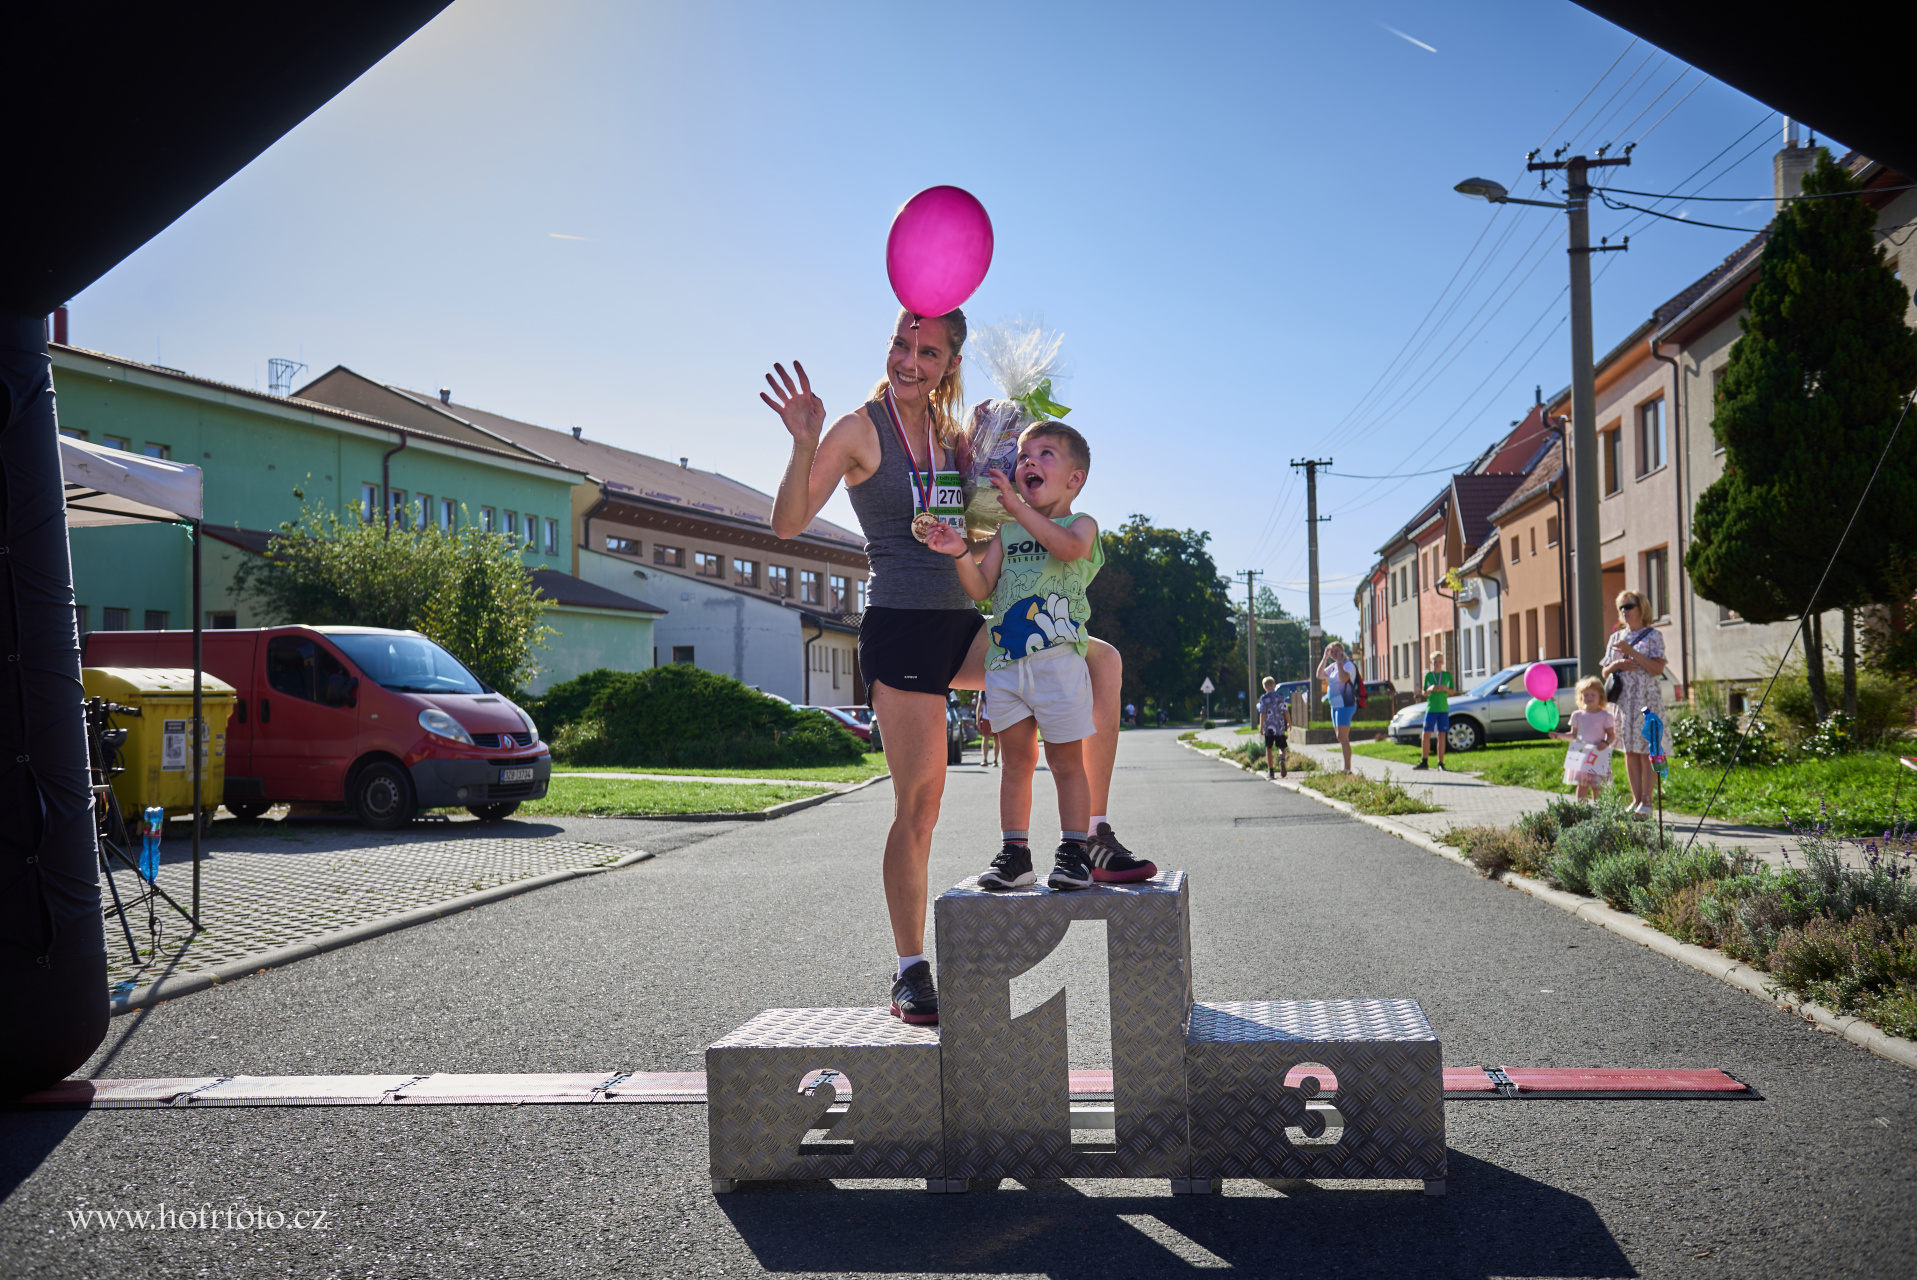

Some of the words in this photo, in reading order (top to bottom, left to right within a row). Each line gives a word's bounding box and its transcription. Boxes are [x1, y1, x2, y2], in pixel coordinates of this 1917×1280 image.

[939, 489, 962, 504] 270
[1007, 540, 1049, 555] SON
[1008, 919, 1117, 1154] 1
[797, 1068, 856, 1156] 2
[1283, 1062, 1345, 1154] 3
